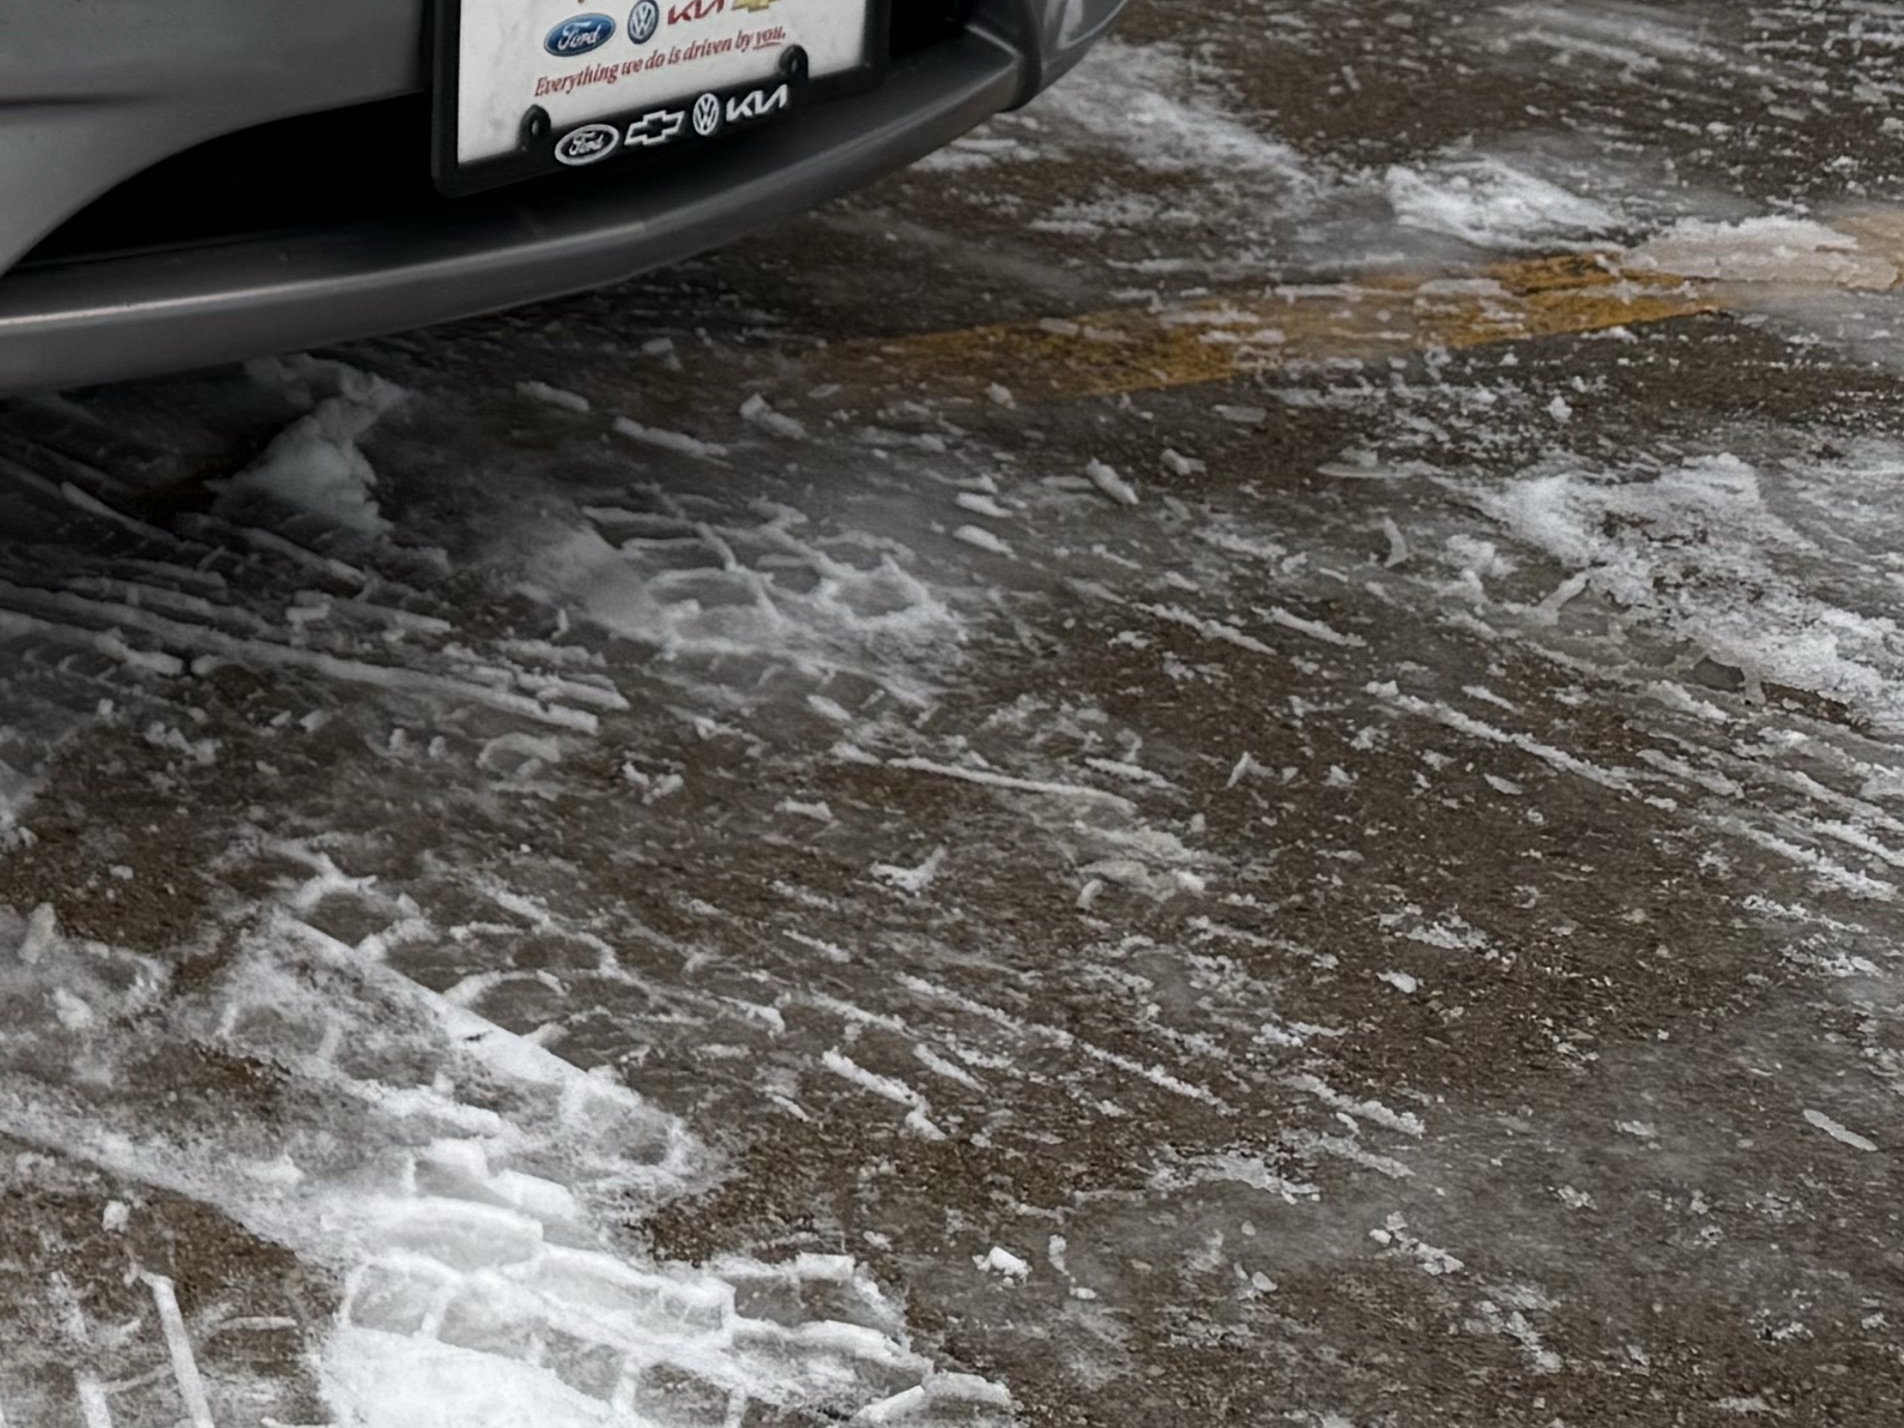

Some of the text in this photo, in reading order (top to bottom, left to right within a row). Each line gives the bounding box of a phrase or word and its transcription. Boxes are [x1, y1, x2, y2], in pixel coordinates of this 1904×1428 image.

[534, 25, 786, 97] Everything we do is driven by you.
